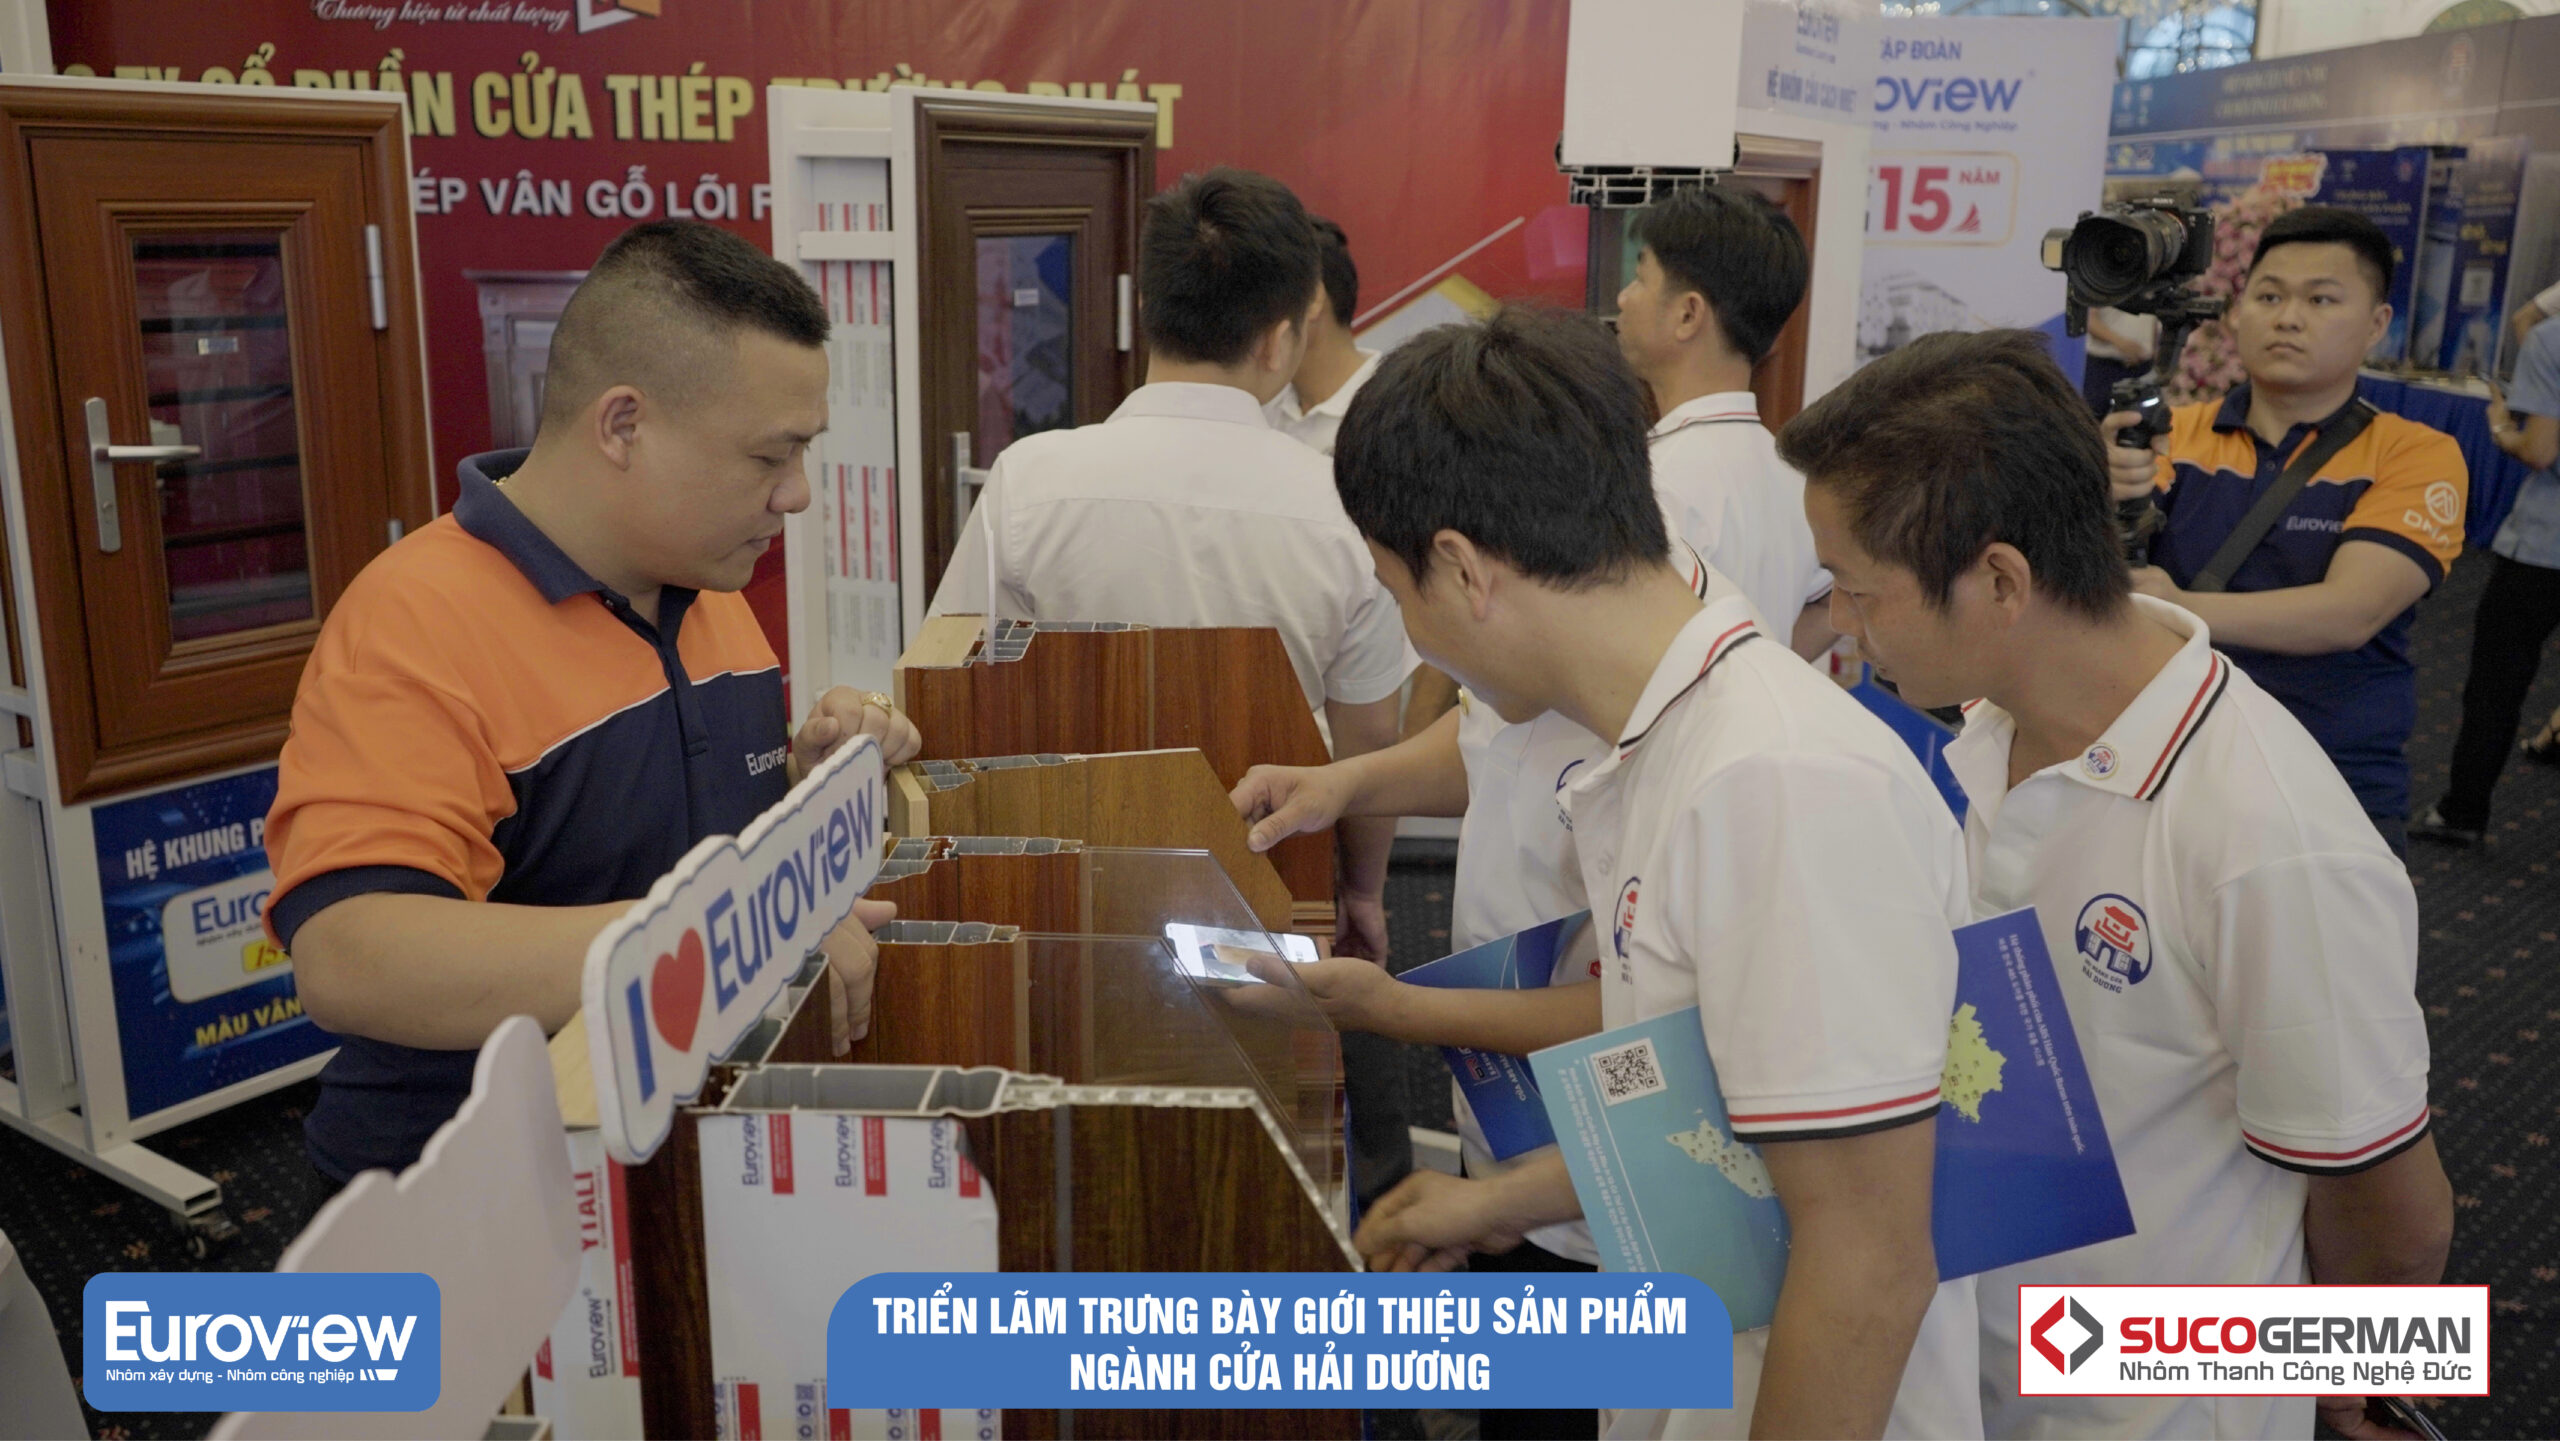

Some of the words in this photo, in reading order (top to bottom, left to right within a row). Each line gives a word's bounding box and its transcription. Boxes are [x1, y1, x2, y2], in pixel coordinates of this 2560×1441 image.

[1880, 36, 1907, 61] ẬP
[472, 50, 594, 139] CỬA
[605, 62, 754, 142] THÉP
[1874, 76, 2023, 112] oview
[413, 167, 468, 215] ÉP
[480, 169, 572, 216] VÂN
[586, 164, 655, 218] GỖ
[667, 173, 737, 220] LÕI
[1879, 166, 1952, 233] 15
[745, 744, 787, 776] Eurovie
[126, 838, 159, 881] HỆ
[164, 822, 246, 870] KHUNG
[191, 889, 271, 936] Euro
[704, 777, 875, 1015] Euroview
[196, 1013, 249, 1048] MÀU
[254, 996, 303, 1028] VÂN
[588, 1298, 608, 1378] Euroview
